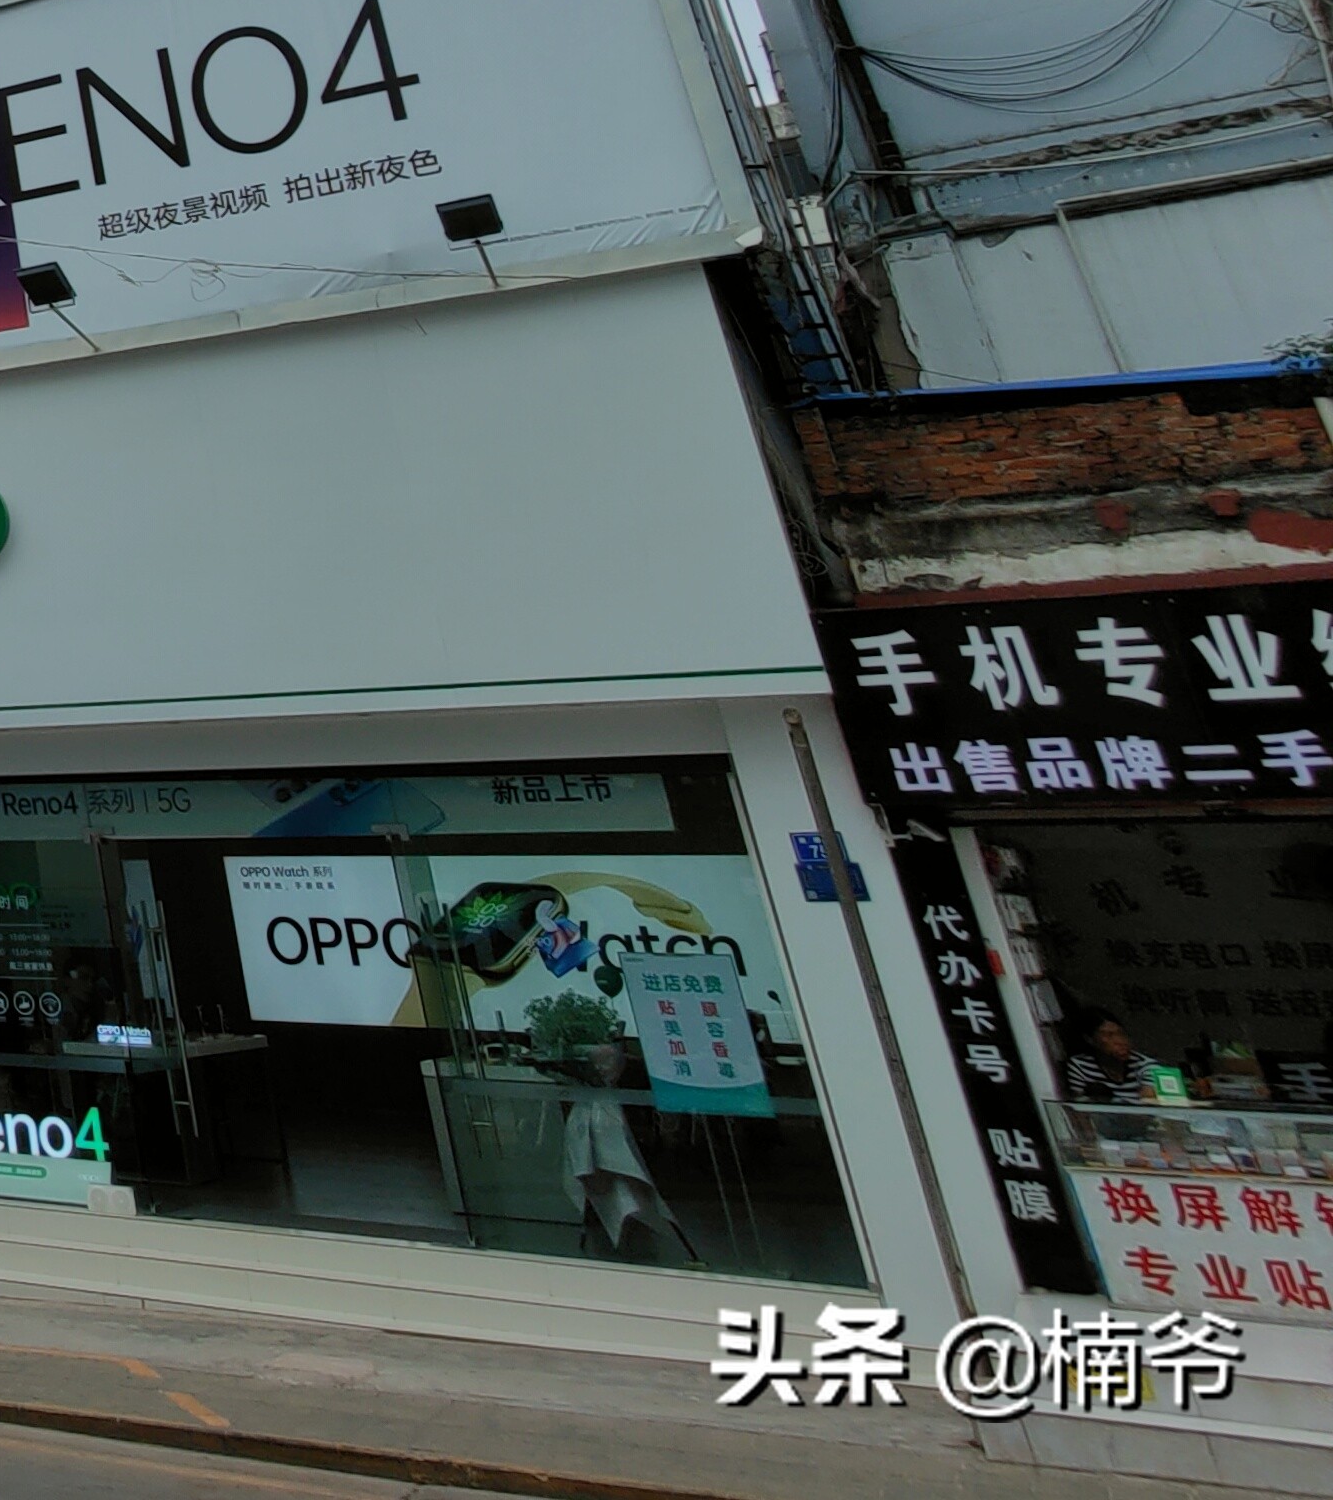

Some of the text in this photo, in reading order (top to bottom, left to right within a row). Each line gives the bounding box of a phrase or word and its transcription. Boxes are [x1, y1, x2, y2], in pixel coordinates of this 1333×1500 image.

[96, 148, 443, 242] 超级夜景视频 拍出新夜色
[1, 791, 78, 816] Reno4
[87, 787, 135, 814] 系列
[156, 787, 192, 814] 5G
[491, 773, 611, 804] 新品上市
[240, 866, 271, 878] OPPO
[272, 866, 310, 878] Watch
[641, 972, 724, 995] 进店免费
